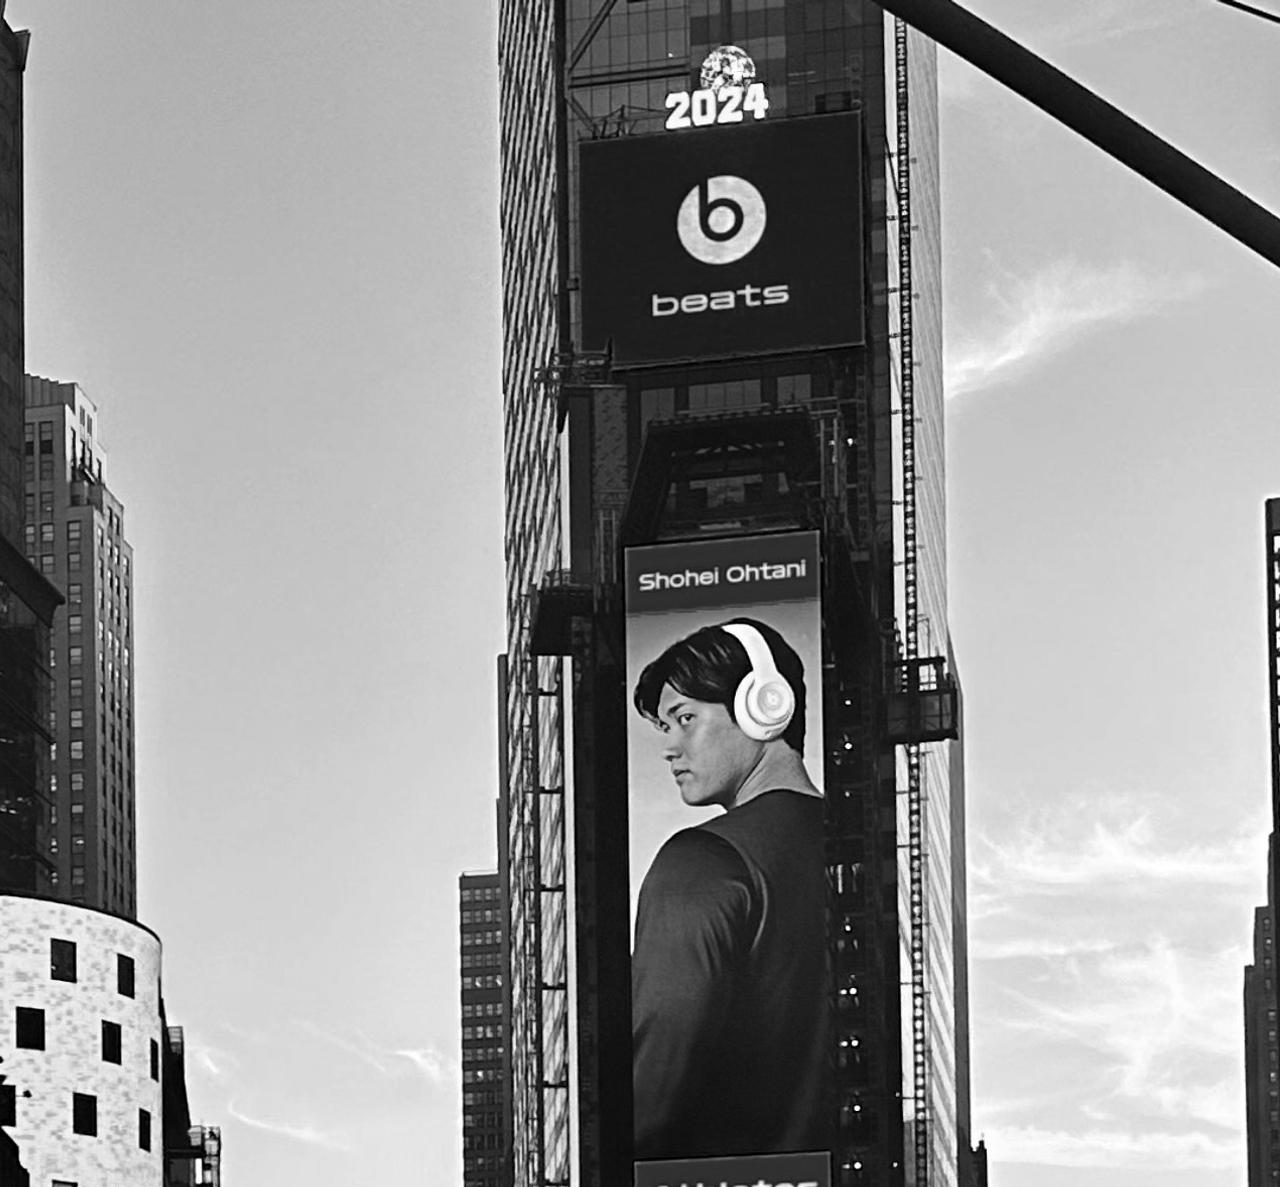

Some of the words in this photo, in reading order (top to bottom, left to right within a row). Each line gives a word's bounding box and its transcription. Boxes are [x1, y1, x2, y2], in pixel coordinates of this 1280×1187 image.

[665, 83, 768, 129] 2024
[652, 284, 790, 317] beats
[638, 568, 720, 592] Shohei
[725, 560, 807, 584] Ohtani
